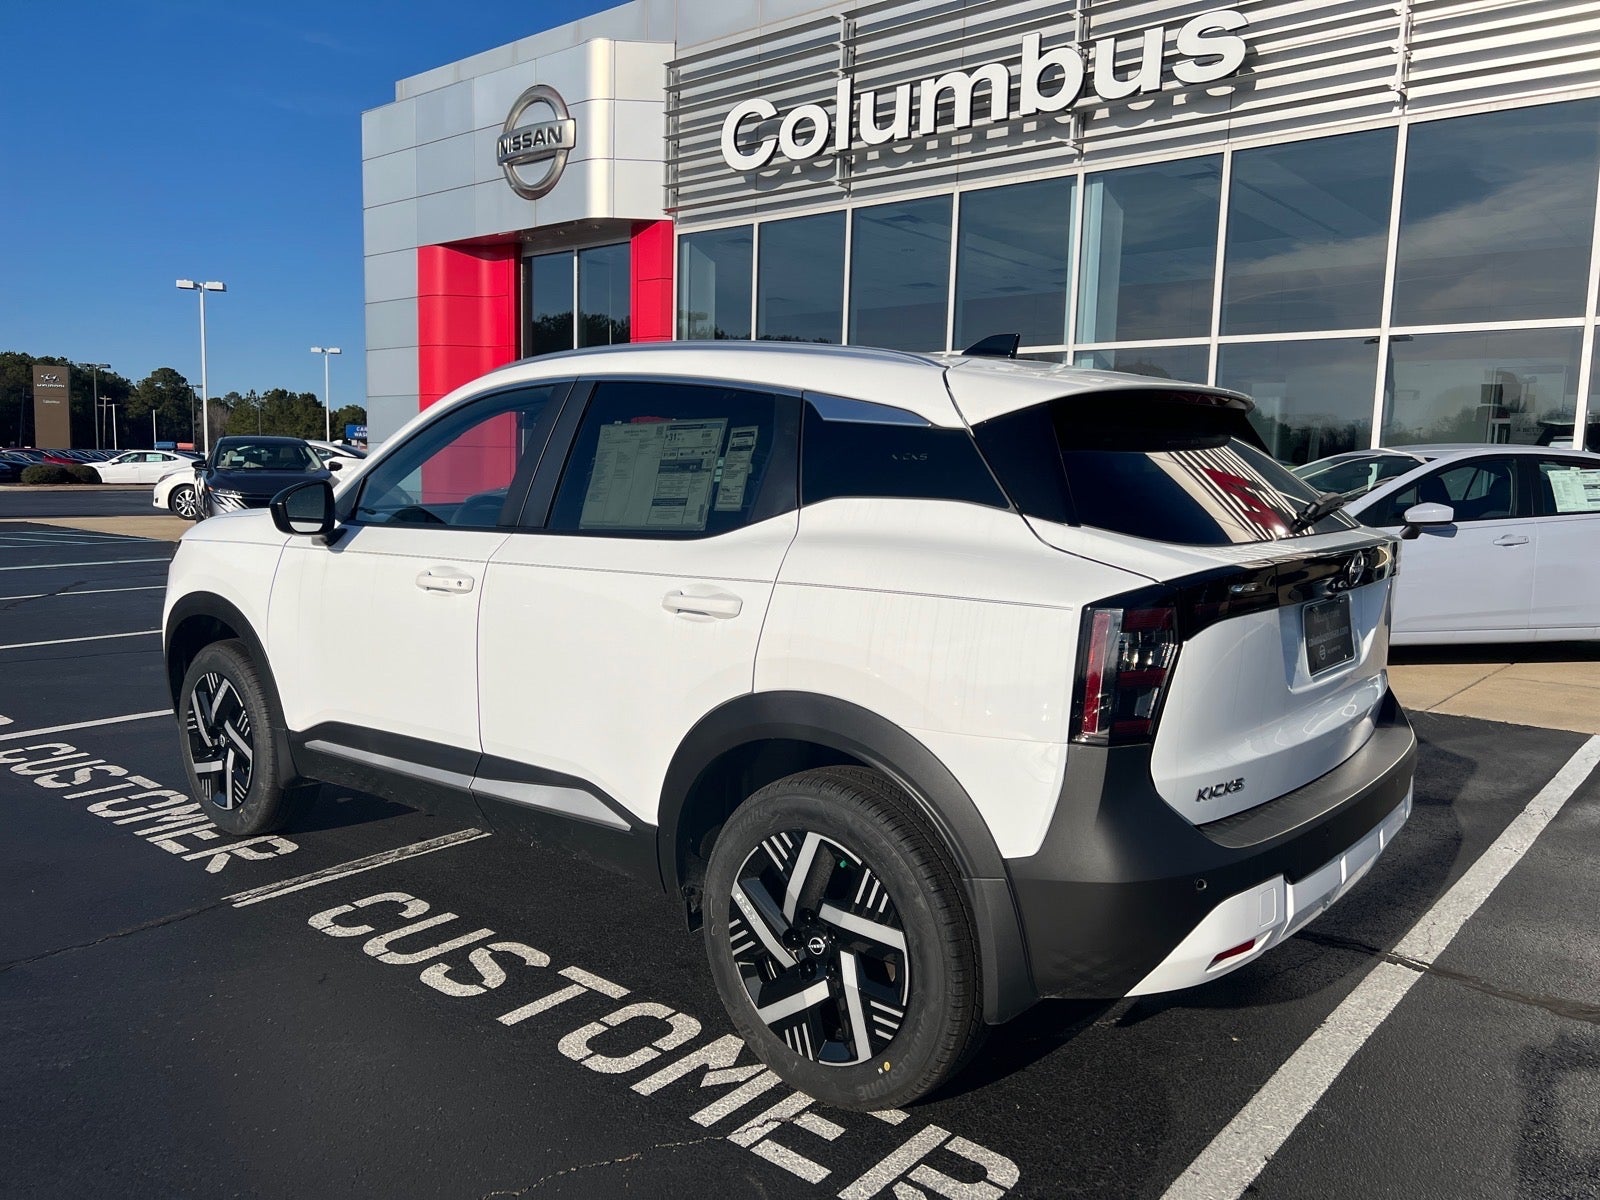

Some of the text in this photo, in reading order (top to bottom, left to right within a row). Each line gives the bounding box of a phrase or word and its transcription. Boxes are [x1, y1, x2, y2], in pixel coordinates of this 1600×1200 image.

[721, 10, 1249, 171] Columbus
[498, 125, 563, 158] NISSAN
[891, 452, 929, 461] KCKS
[0, 742, 299, 874] CUSTOMER
[1195, 777, 1245, 802] KICKS
[307, 891, 1020, 1200] CUSTOMER
